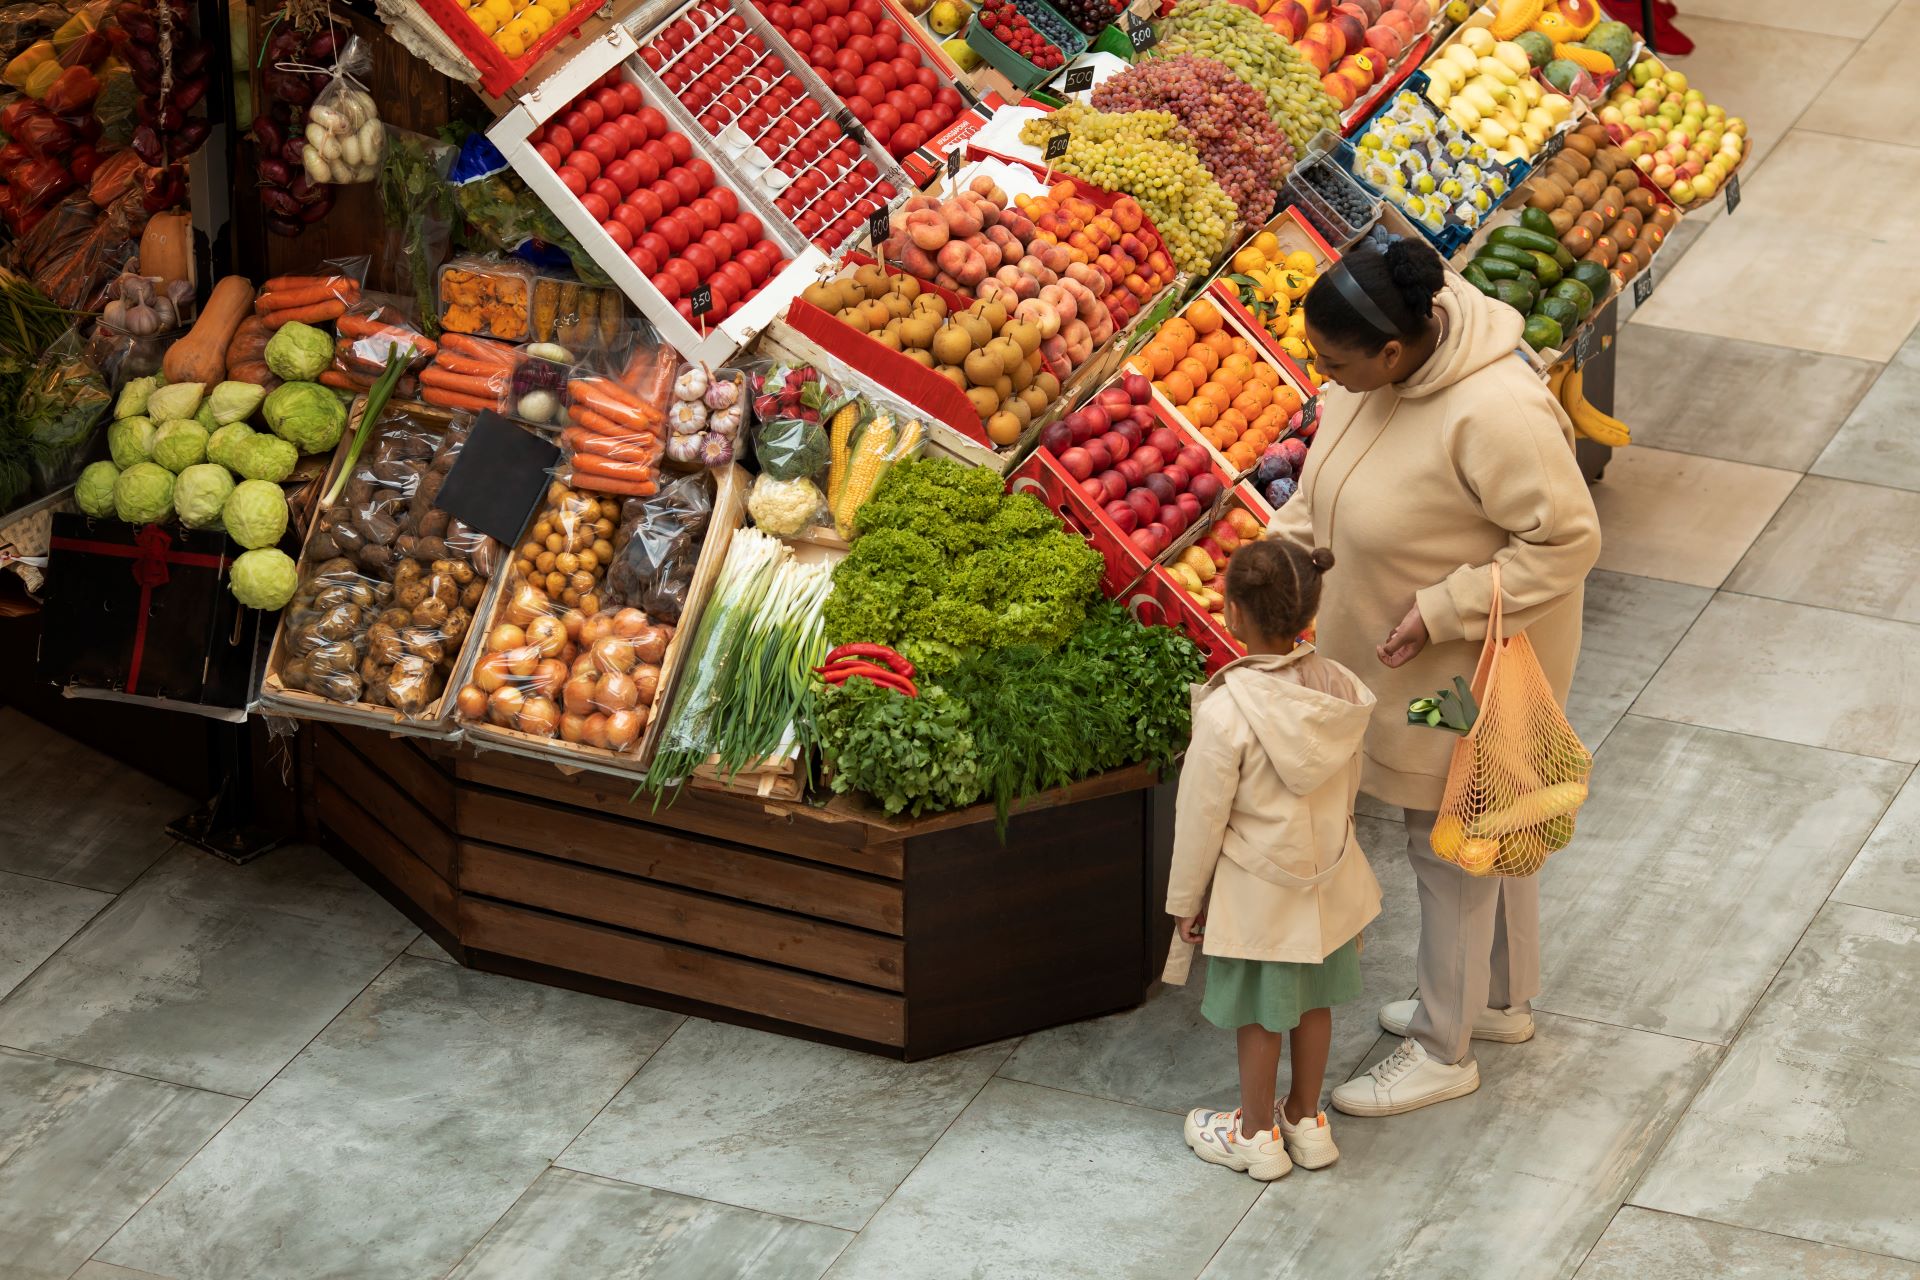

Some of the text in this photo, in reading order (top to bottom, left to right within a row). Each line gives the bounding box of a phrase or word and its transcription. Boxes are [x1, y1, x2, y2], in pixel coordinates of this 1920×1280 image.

[1131, 27, 1151, 46] 500
[1067, 71, 1093, 86] 500
[1050, 139, 1068, 155] 500
[872, 216, 888, 238] 600
[693, 290, 711, 309] 350
